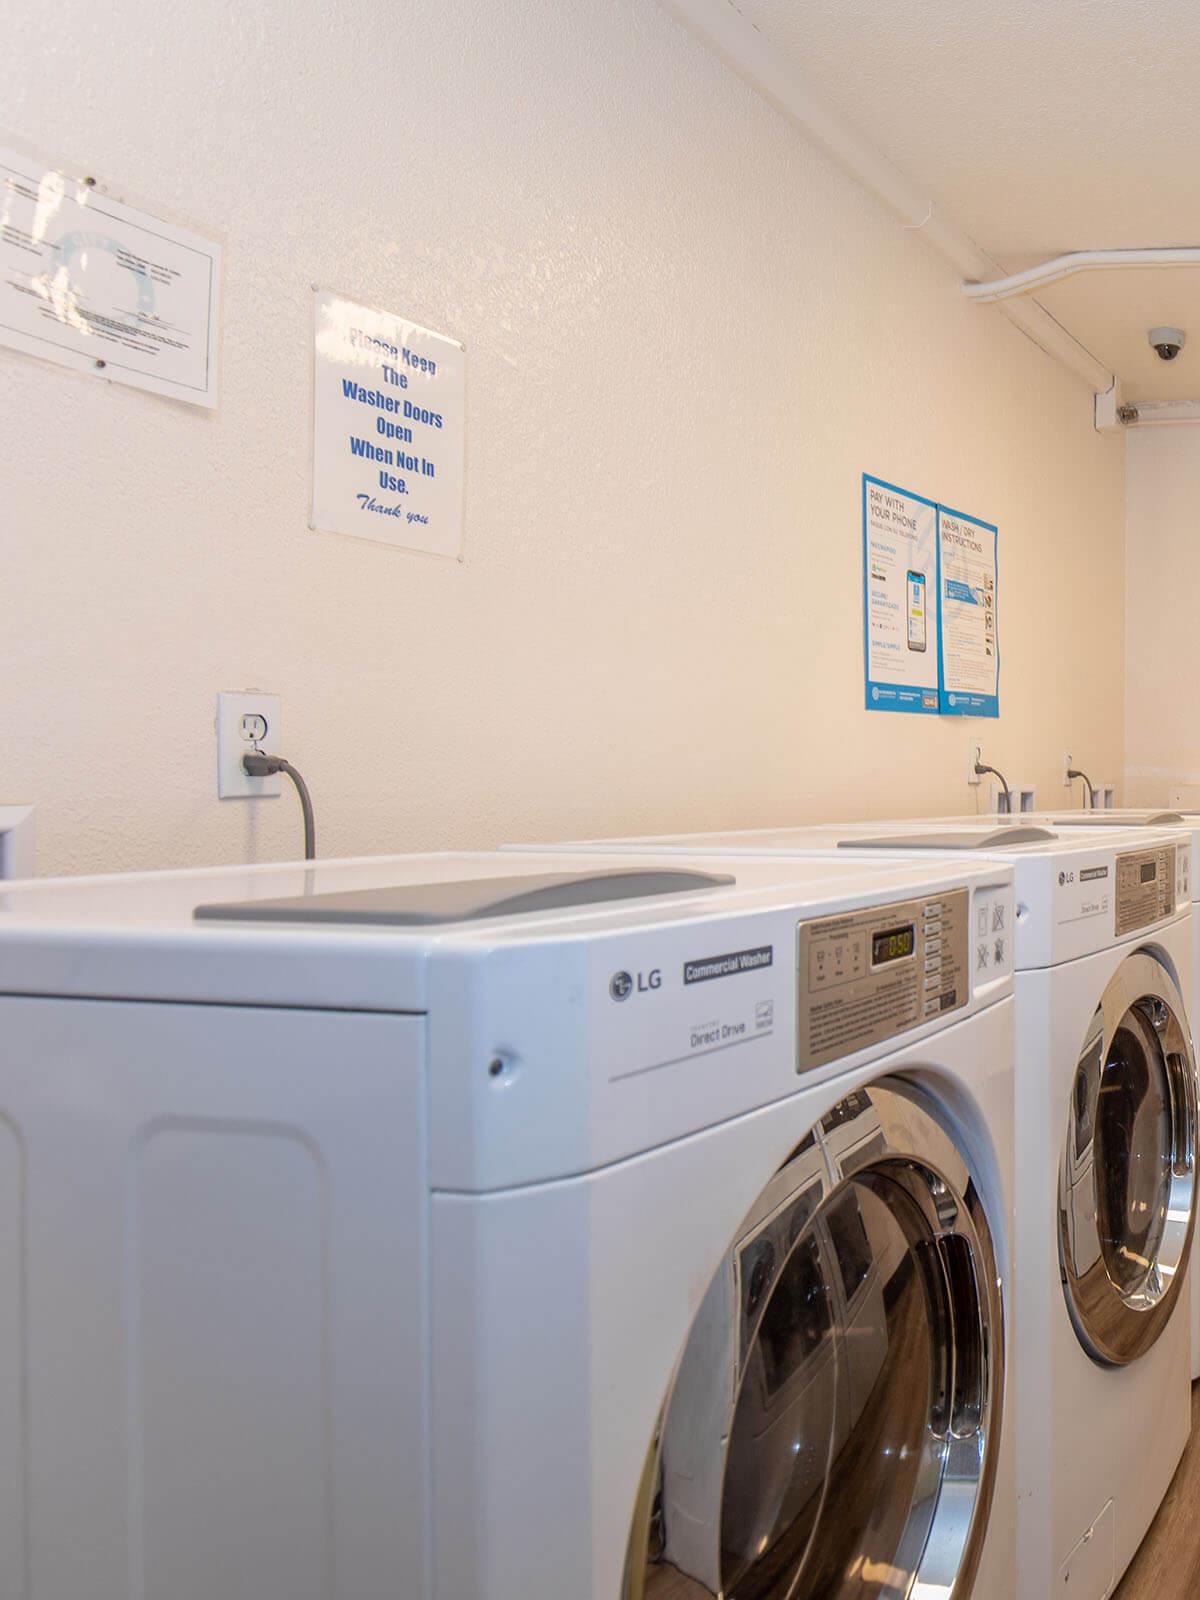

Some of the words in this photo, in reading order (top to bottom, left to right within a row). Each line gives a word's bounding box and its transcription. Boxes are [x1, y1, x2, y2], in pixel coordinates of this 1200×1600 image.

[381, 364, 408, 389] The
[342, 378, 401, 414] Washer
[403, 399, 442, 429] Doors
[376, 416, 413, 443] Open
[349, 435, 393, 465] When
[396, 450, 419, 473] Not
[422, 457, 435, 477] In
[379, 470, 409, 495] Use.
[356, 493, 401, 518] Thank
[406, 511, 429, 525] you
[870, 489, 883, 504] PAY
[885, 495, 905, 513] WITH
[870, 503, 891, 521] YOUR
[892, 512, 917, 531] PHONE
[942, 519, 959, 532] WASH
[963, 526, 975, 539] DRY
[942, 532, 983, 553] INSTRUCTIONS
[1066, 871, 1074, 883] LG
[637, 969, 662, 992] LG
[686, 957, 739, 981] Commercial
[739, 951, 771, 969] Washer
[690, 1027, 720, 1048] Direct
[722, 1021, 747, 1039] Drive
